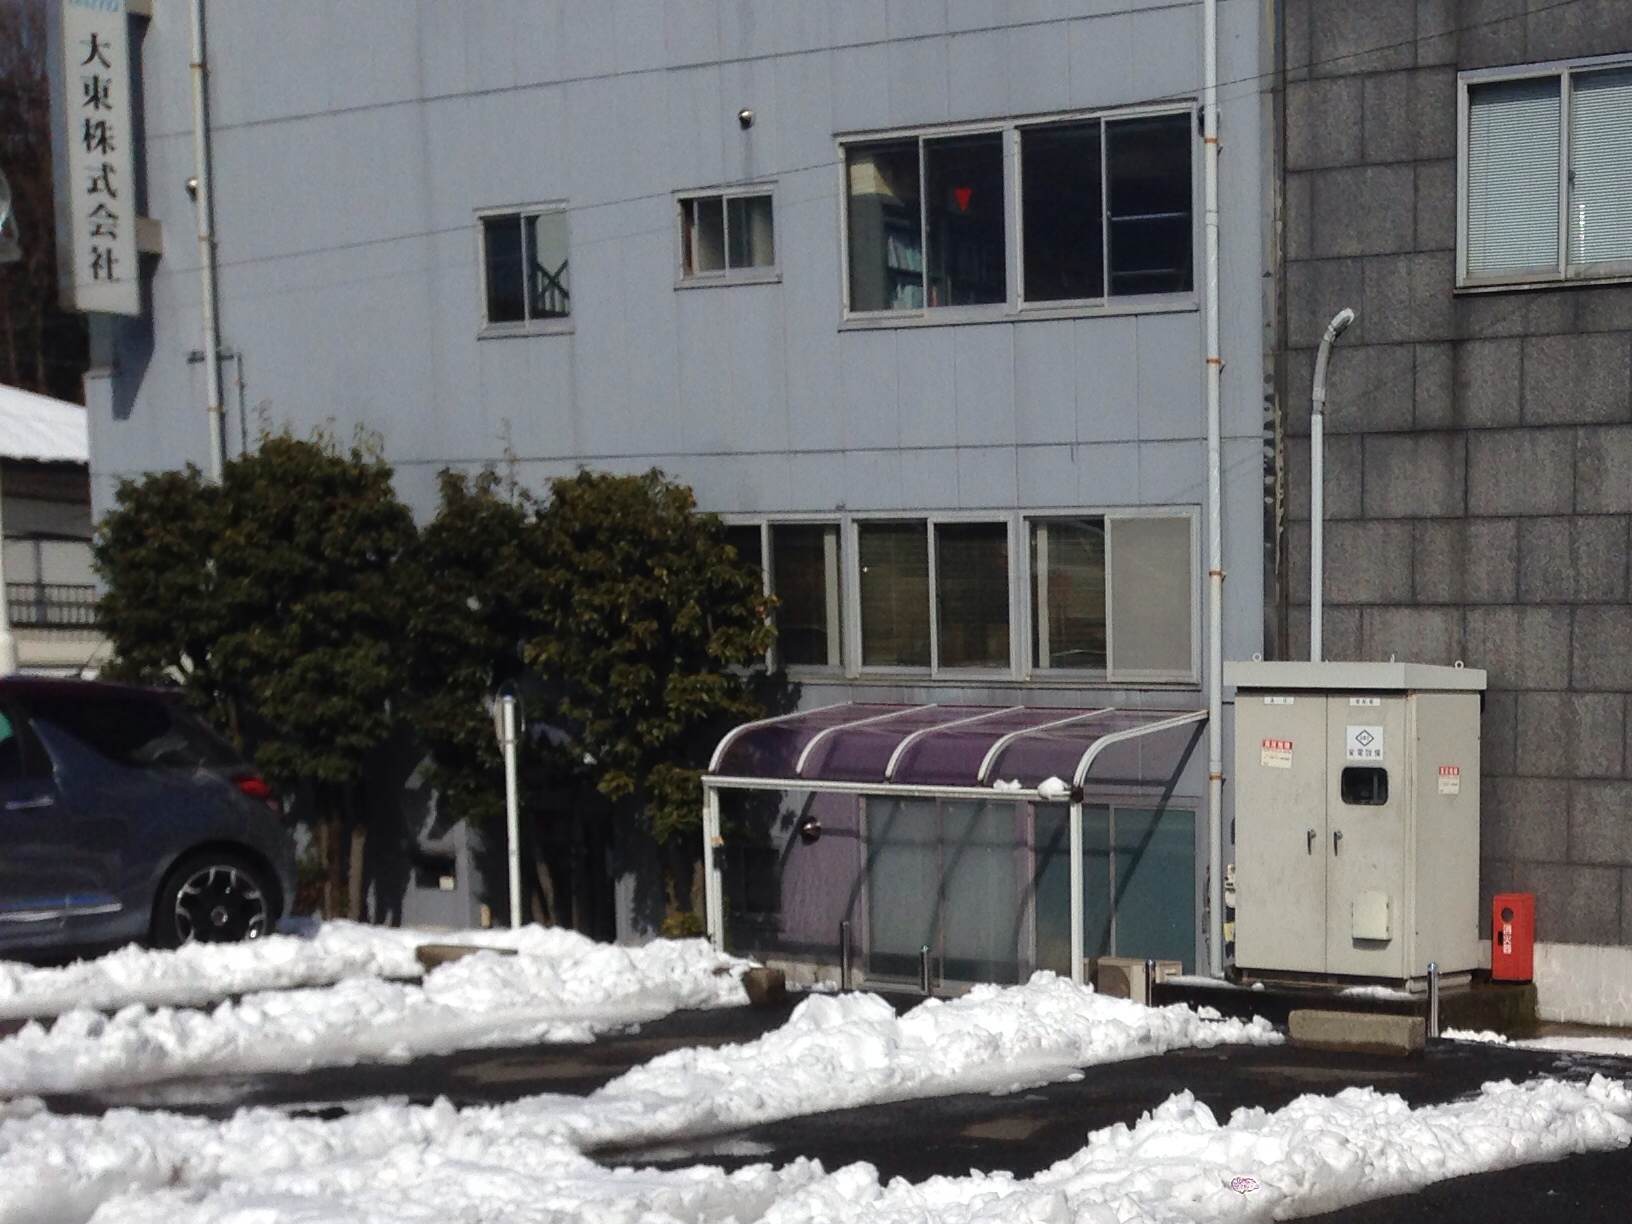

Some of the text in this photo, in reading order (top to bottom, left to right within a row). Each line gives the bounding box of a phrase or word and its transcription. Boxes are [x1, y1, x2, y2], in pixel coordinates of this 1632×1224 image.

[80, 32, 120, 282] 大東株式会社
